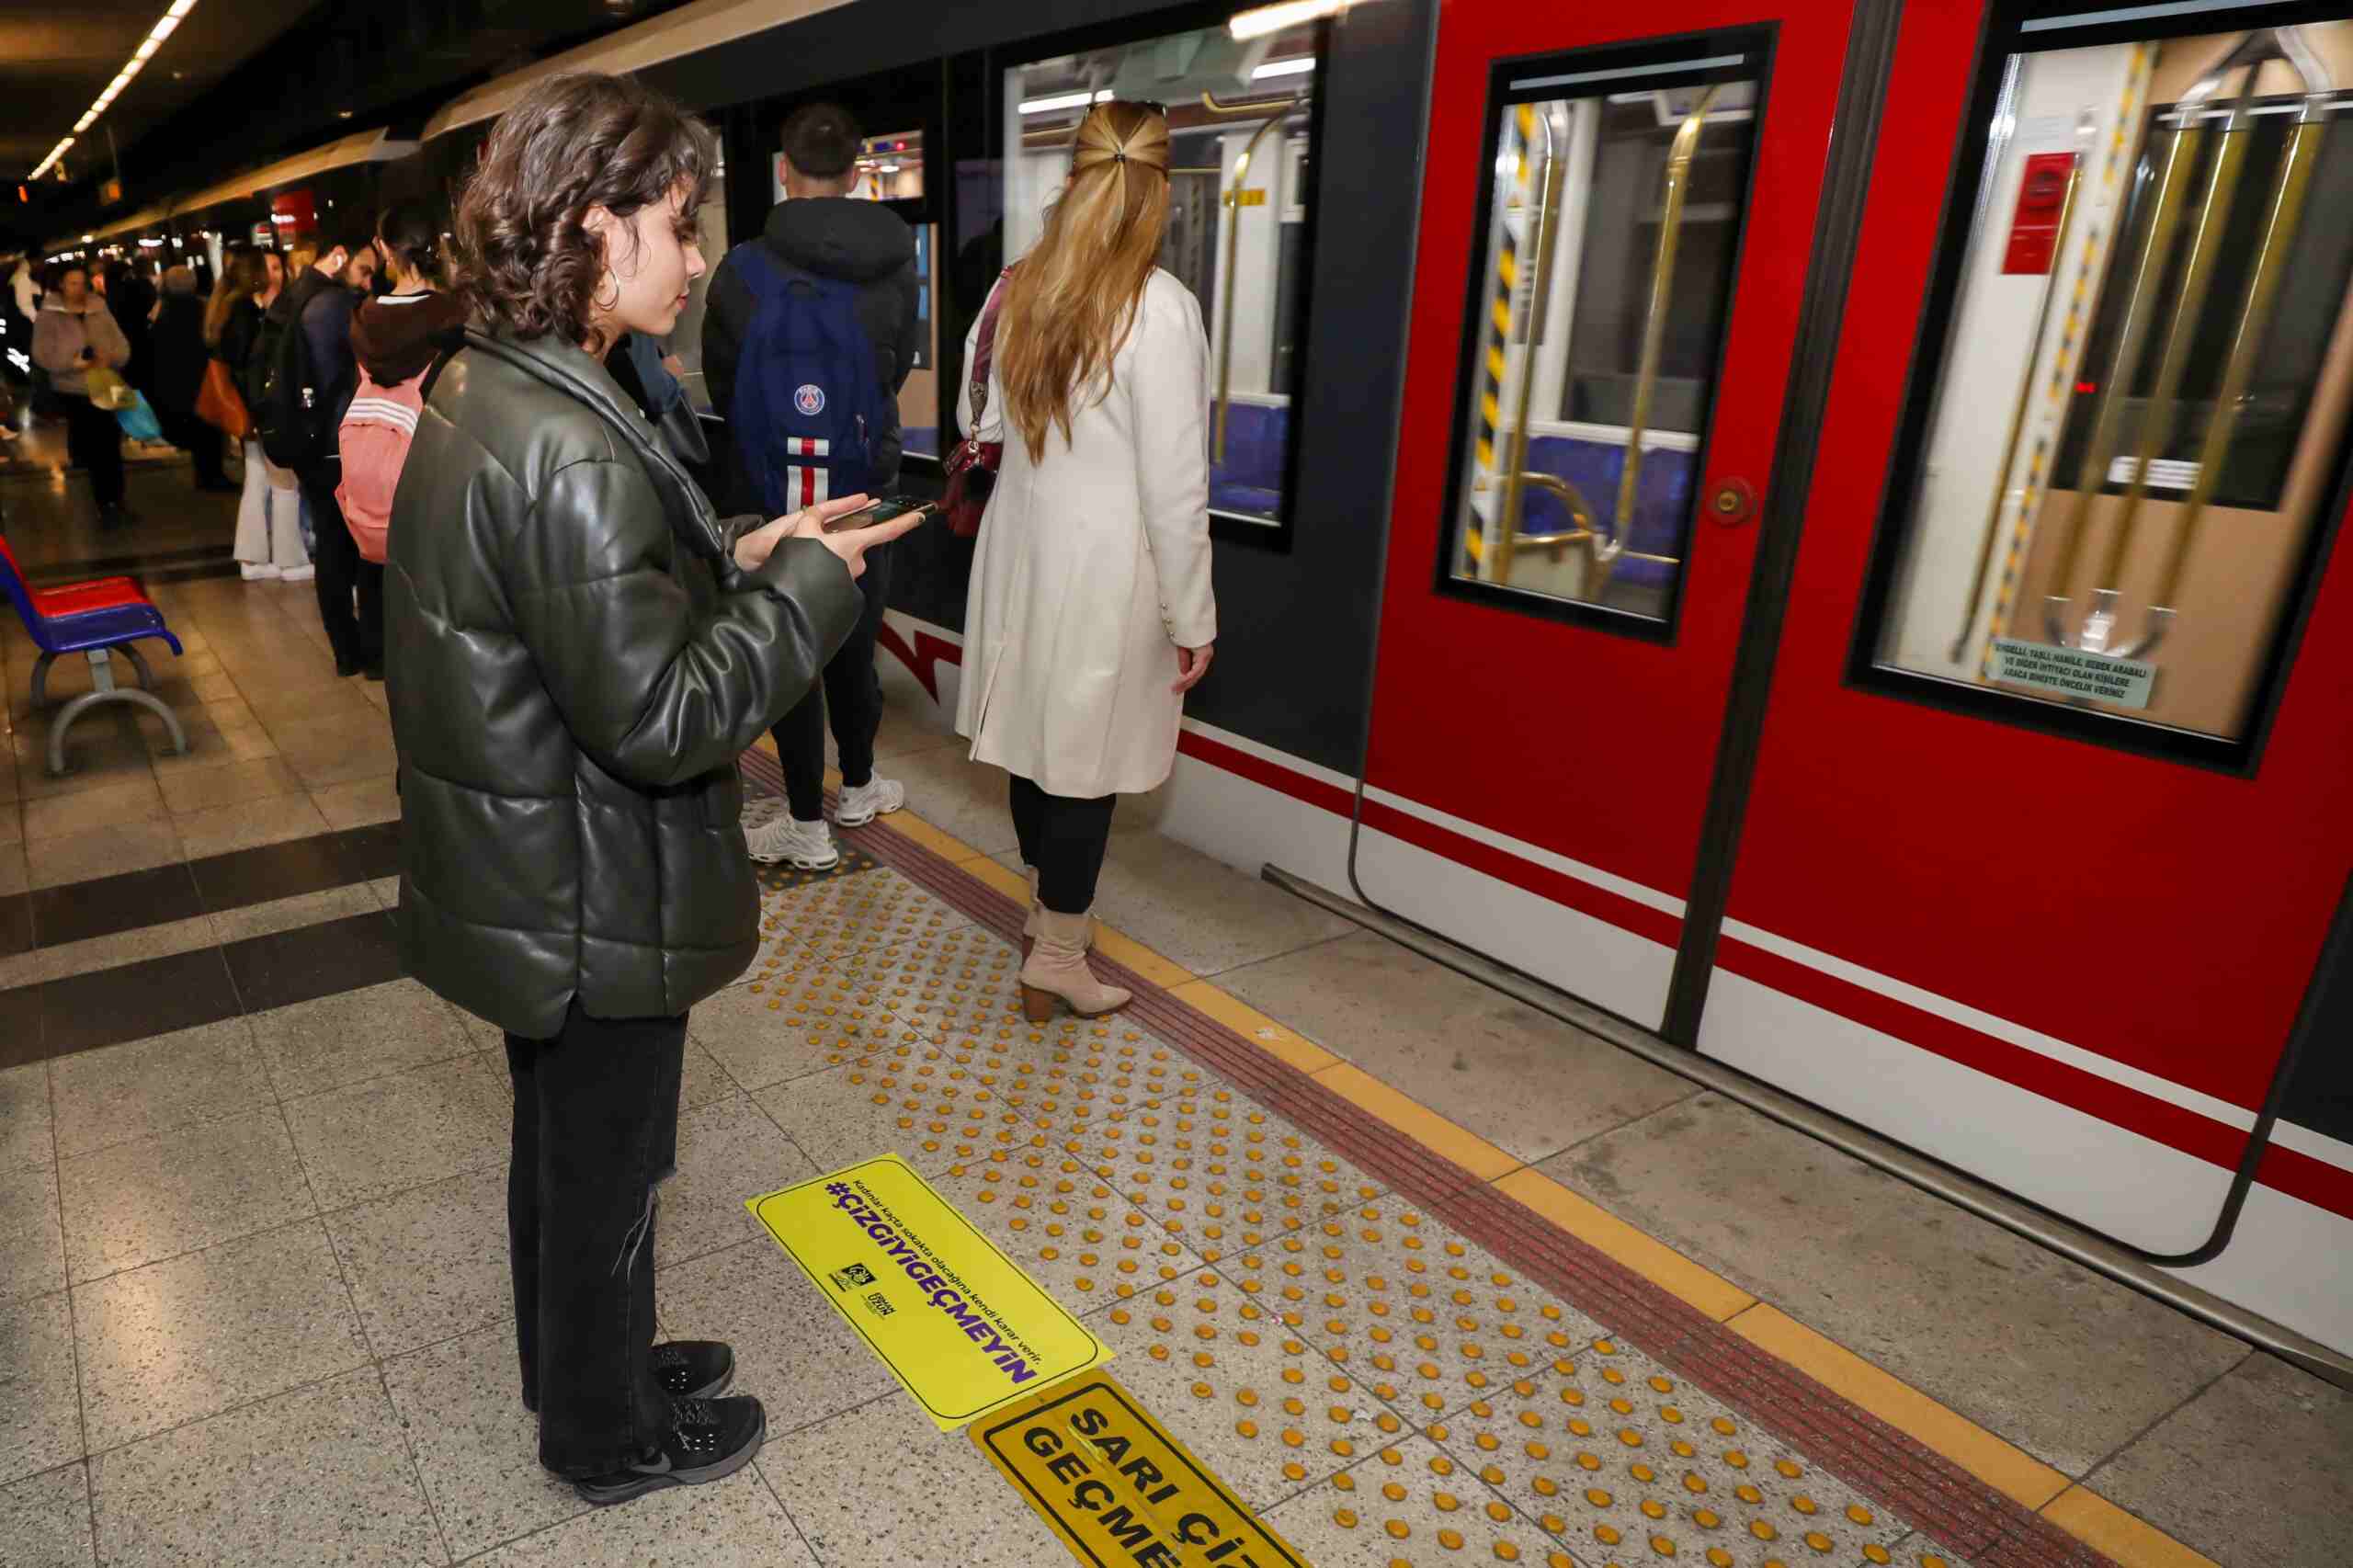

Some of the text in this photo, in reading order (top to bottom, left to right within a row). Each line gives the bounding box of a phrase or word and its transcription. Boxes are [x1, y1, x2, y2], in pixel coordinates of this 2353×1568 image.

[824, 1181, 1037, 1383] #ÇİZGİYİGEÇMEYİN
[853, 1179, 1041, 1365] Kadınlar kaçta sokakta olacağına kendi karar verir.
[1070, 1408, 1180, 1505] SARI
